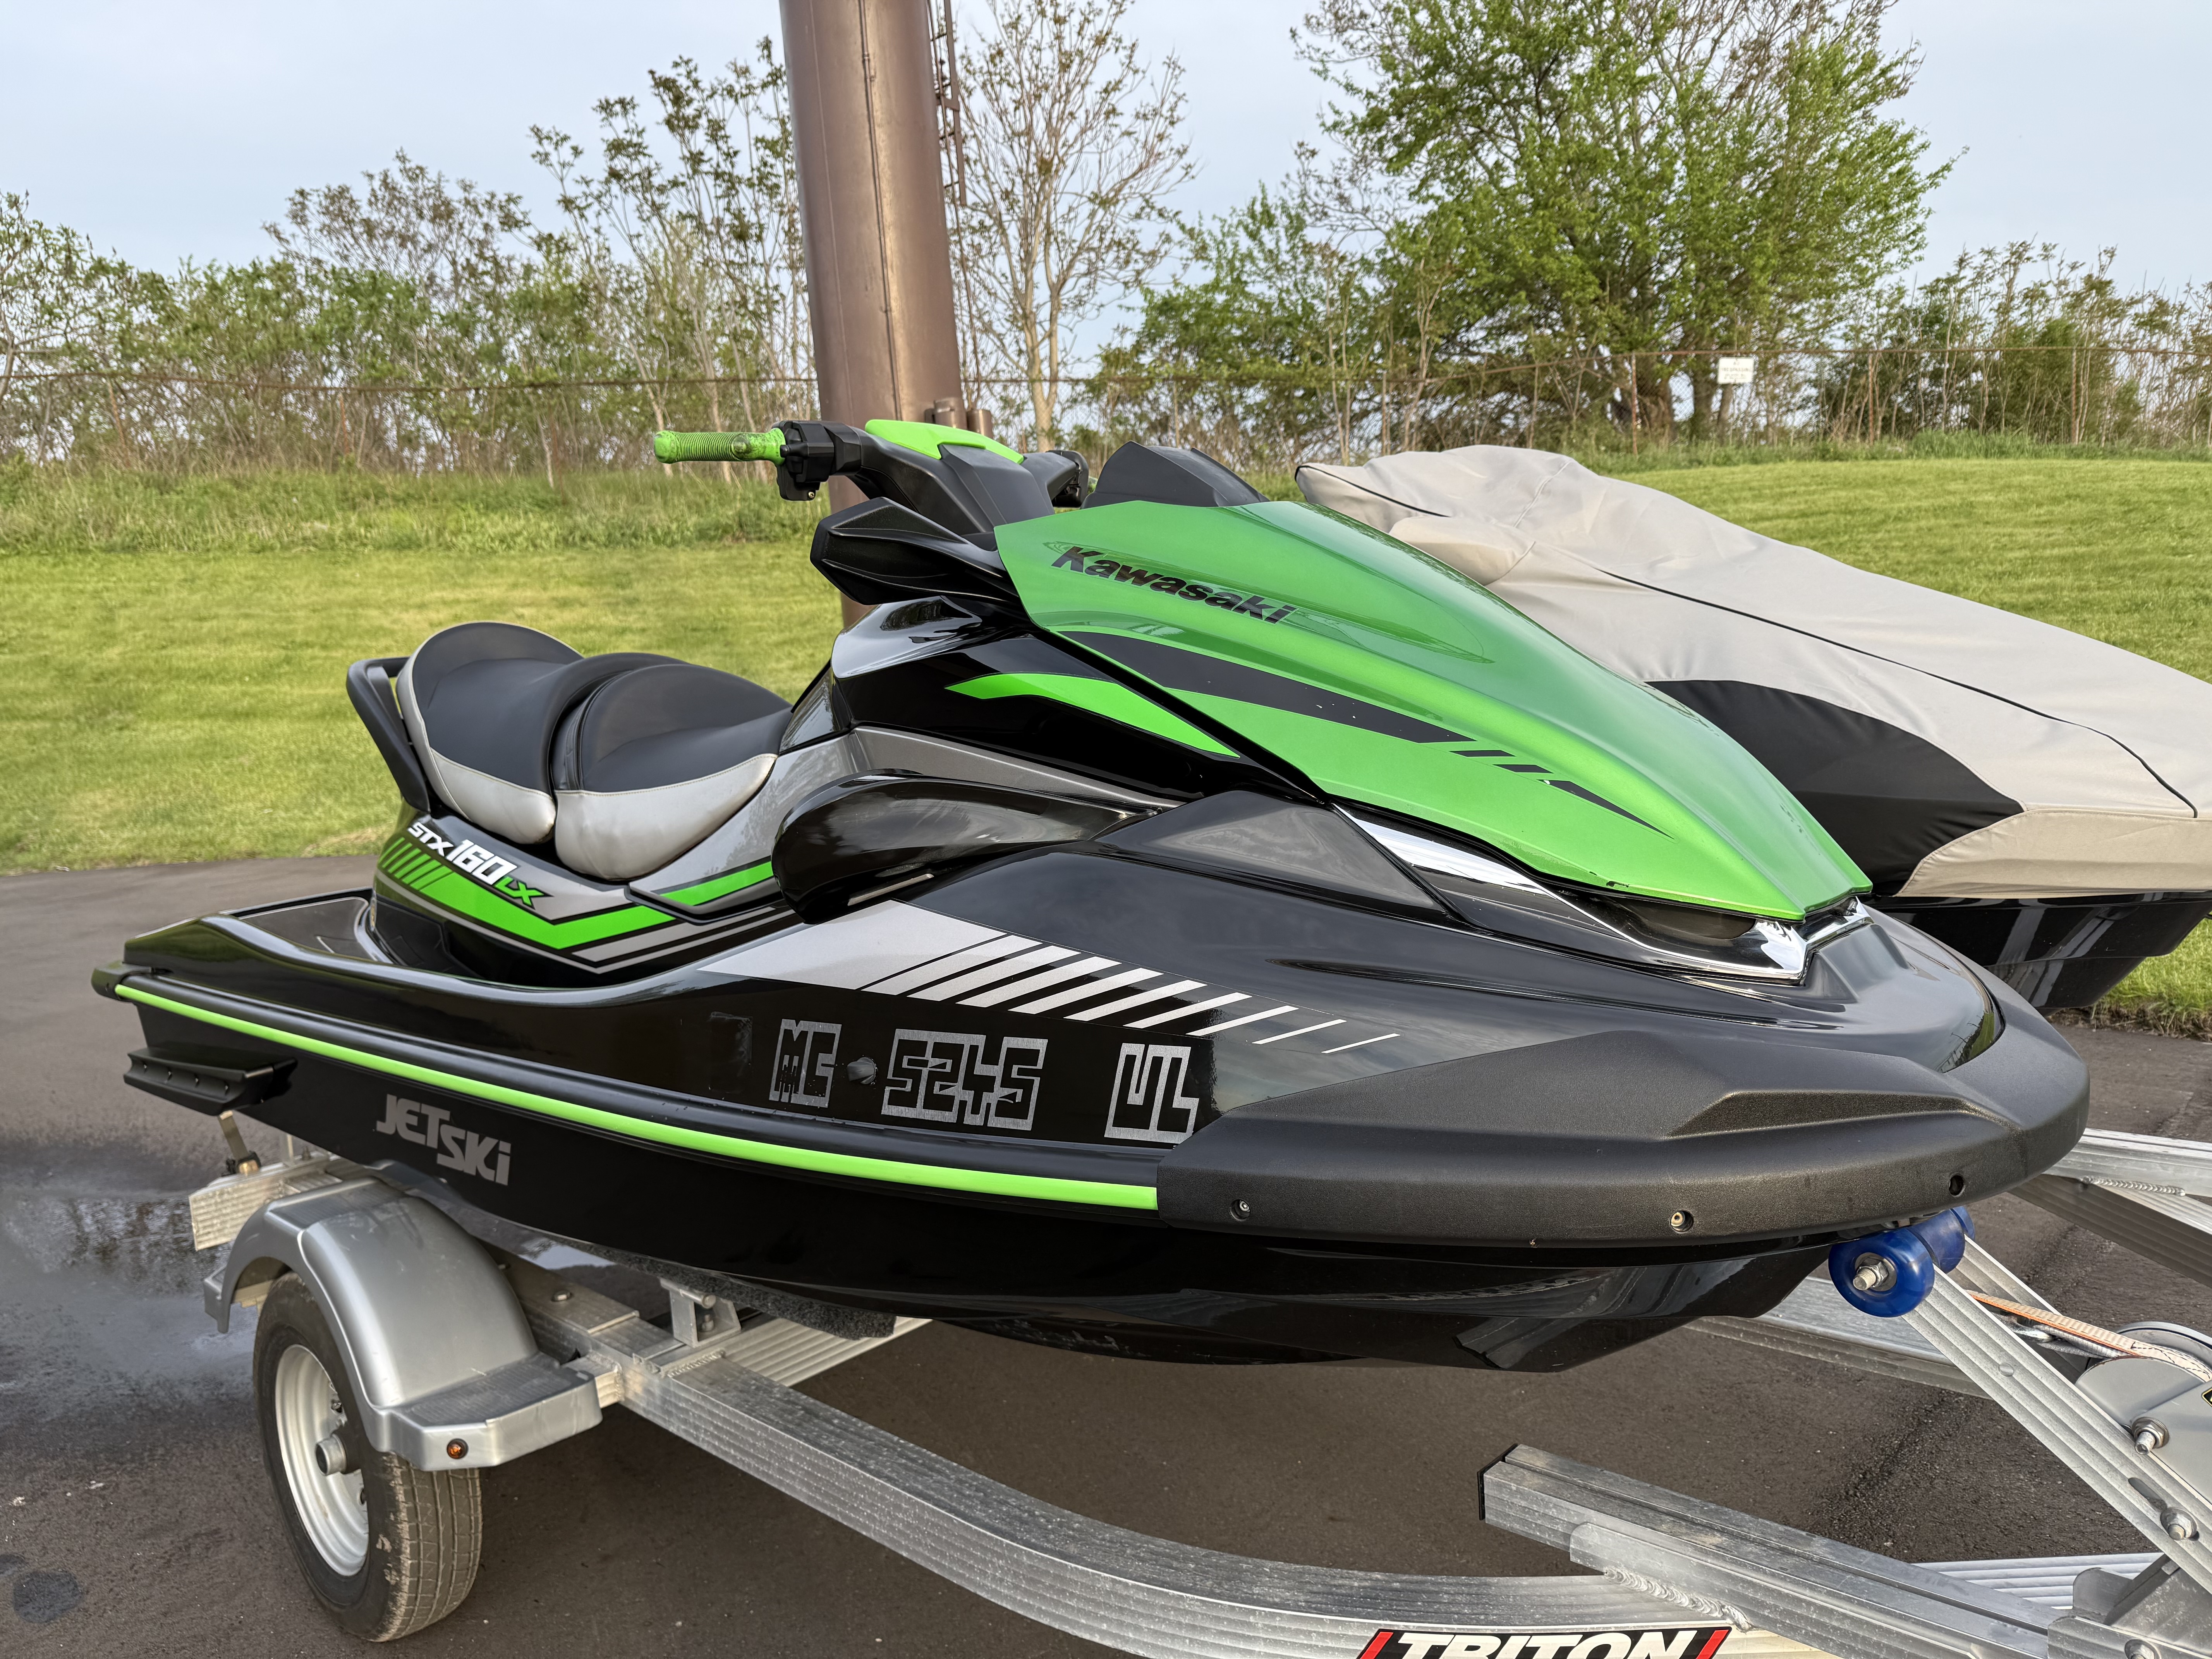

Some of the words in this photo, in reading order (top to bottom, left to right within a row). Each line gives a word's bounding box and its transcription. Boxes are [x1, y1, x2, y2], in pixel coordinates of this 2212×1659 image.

[1051, 546, 1297, 623] Kawasaki
[407, 822, 454, 857] STX
[1104, 1043, 1199, 1144] UL
